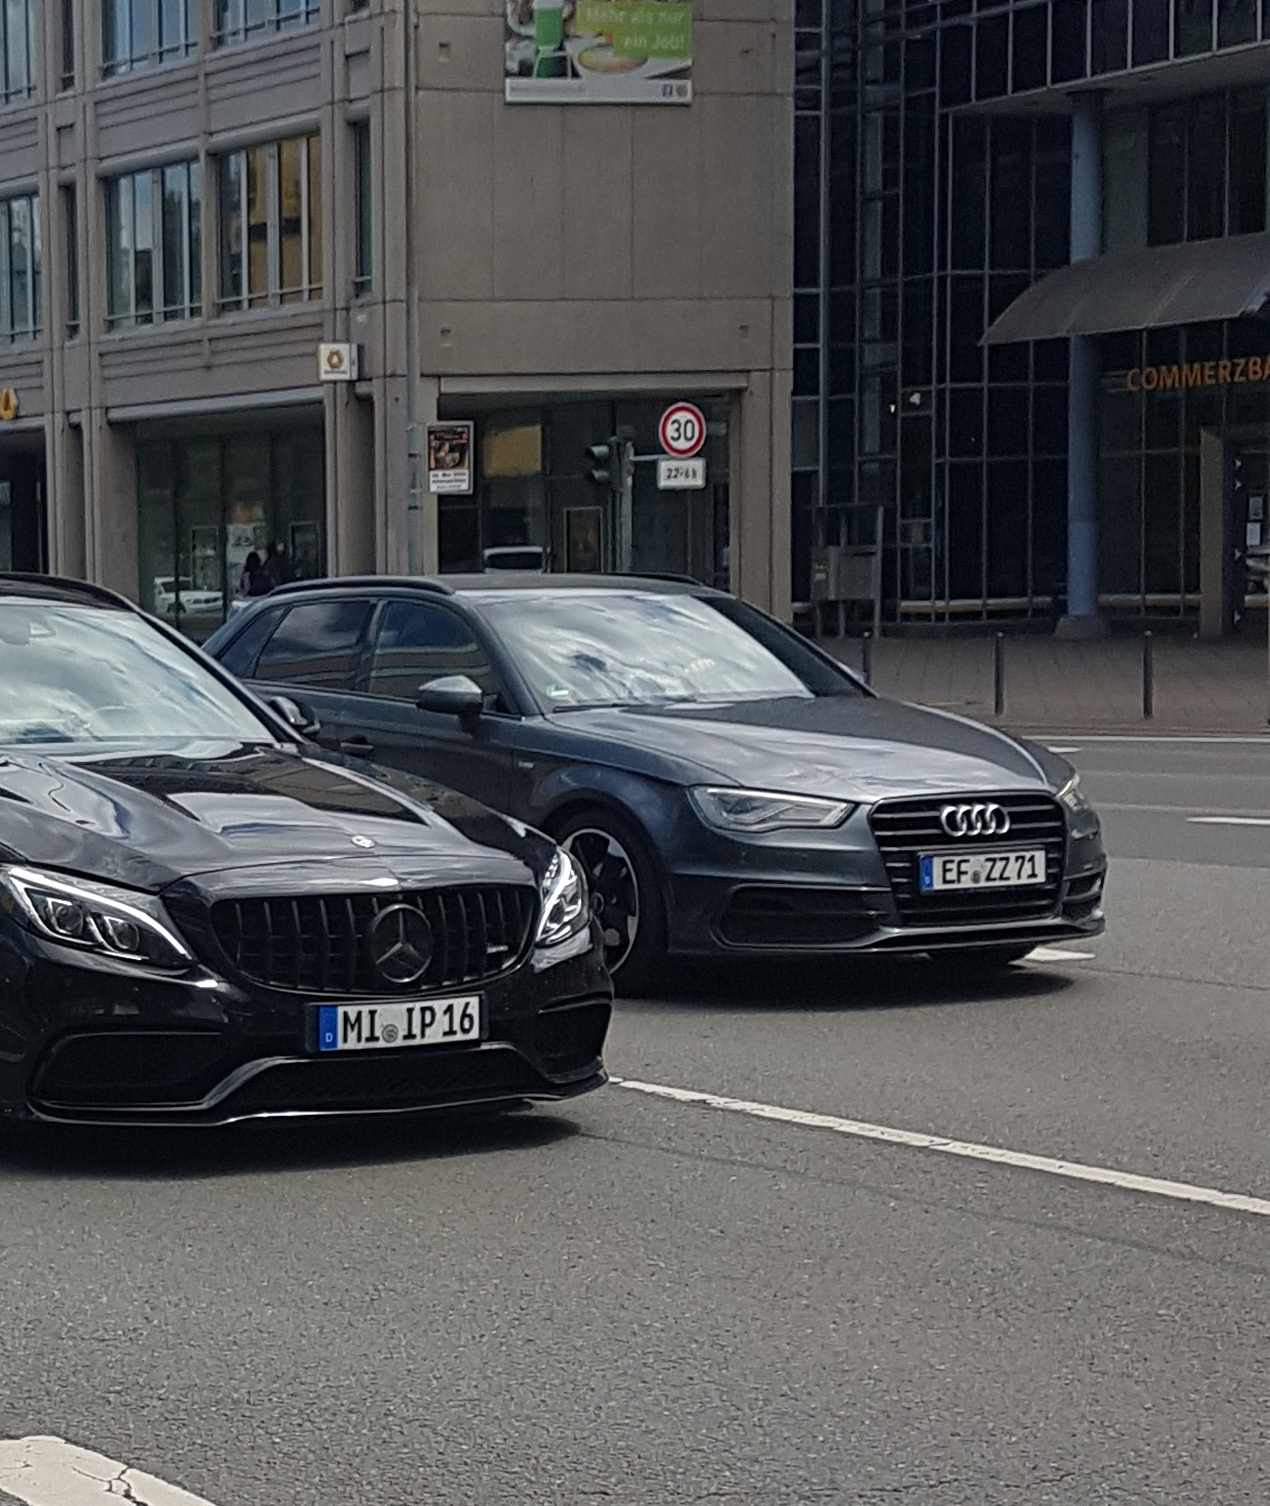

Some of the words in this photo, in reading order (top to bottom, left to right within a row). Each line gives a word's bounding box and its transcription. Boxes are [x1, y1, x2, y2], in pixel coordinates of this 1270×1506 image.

[670, 418, 695, 442] 30
[941, 858, 971, 885] EF
[325, 1032, 333, 1043] D
[342, 1009, 380, 1044] MI
